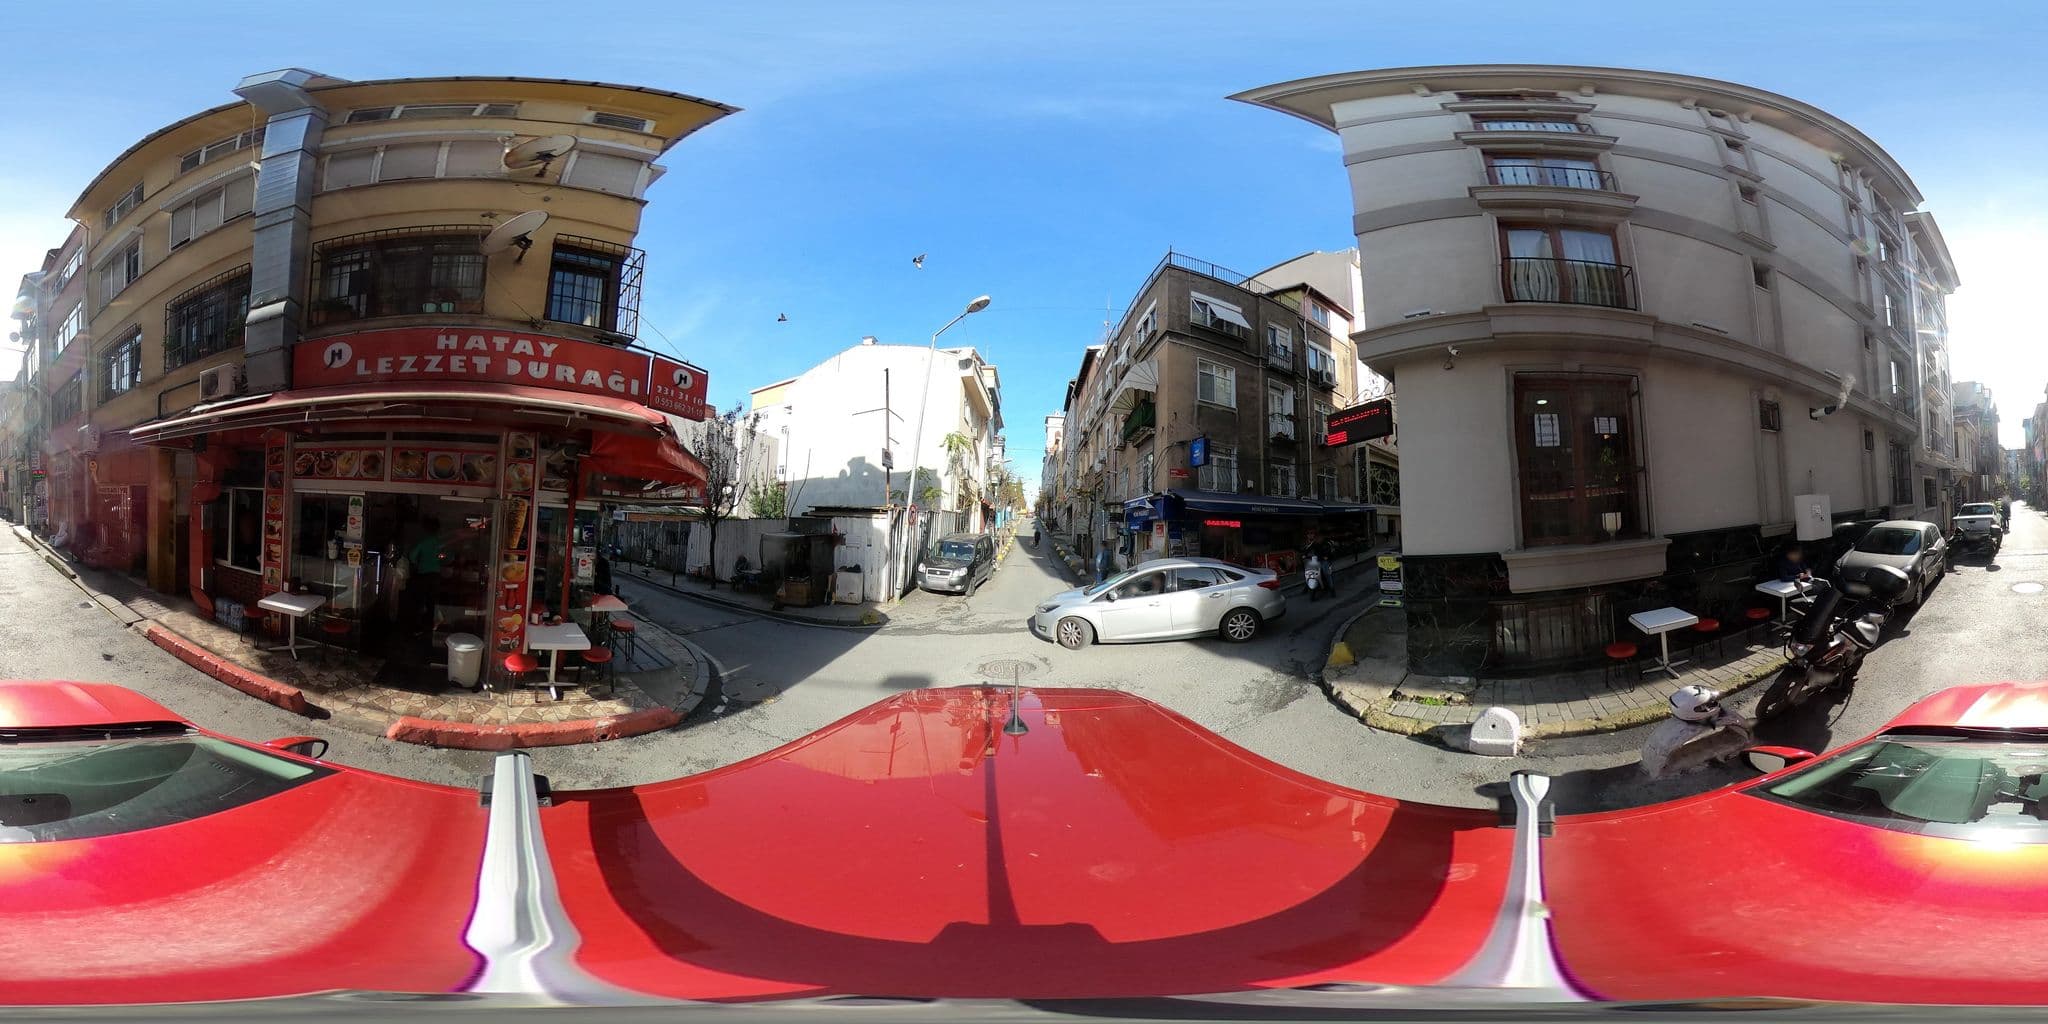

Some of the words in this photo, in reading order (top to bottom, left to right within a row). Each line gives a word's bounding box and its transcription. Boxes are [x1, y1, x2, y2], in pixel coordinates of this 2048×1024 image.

[436, 335, 559, 358] HATAY
[356, 355, 491, 375] LEZZET
[507, 358, 640, 396] DURAĞI
[656, 385, 675, 397] 231
[678, 391, 689, 401] 31
[693, 397, 703, 406] 10
